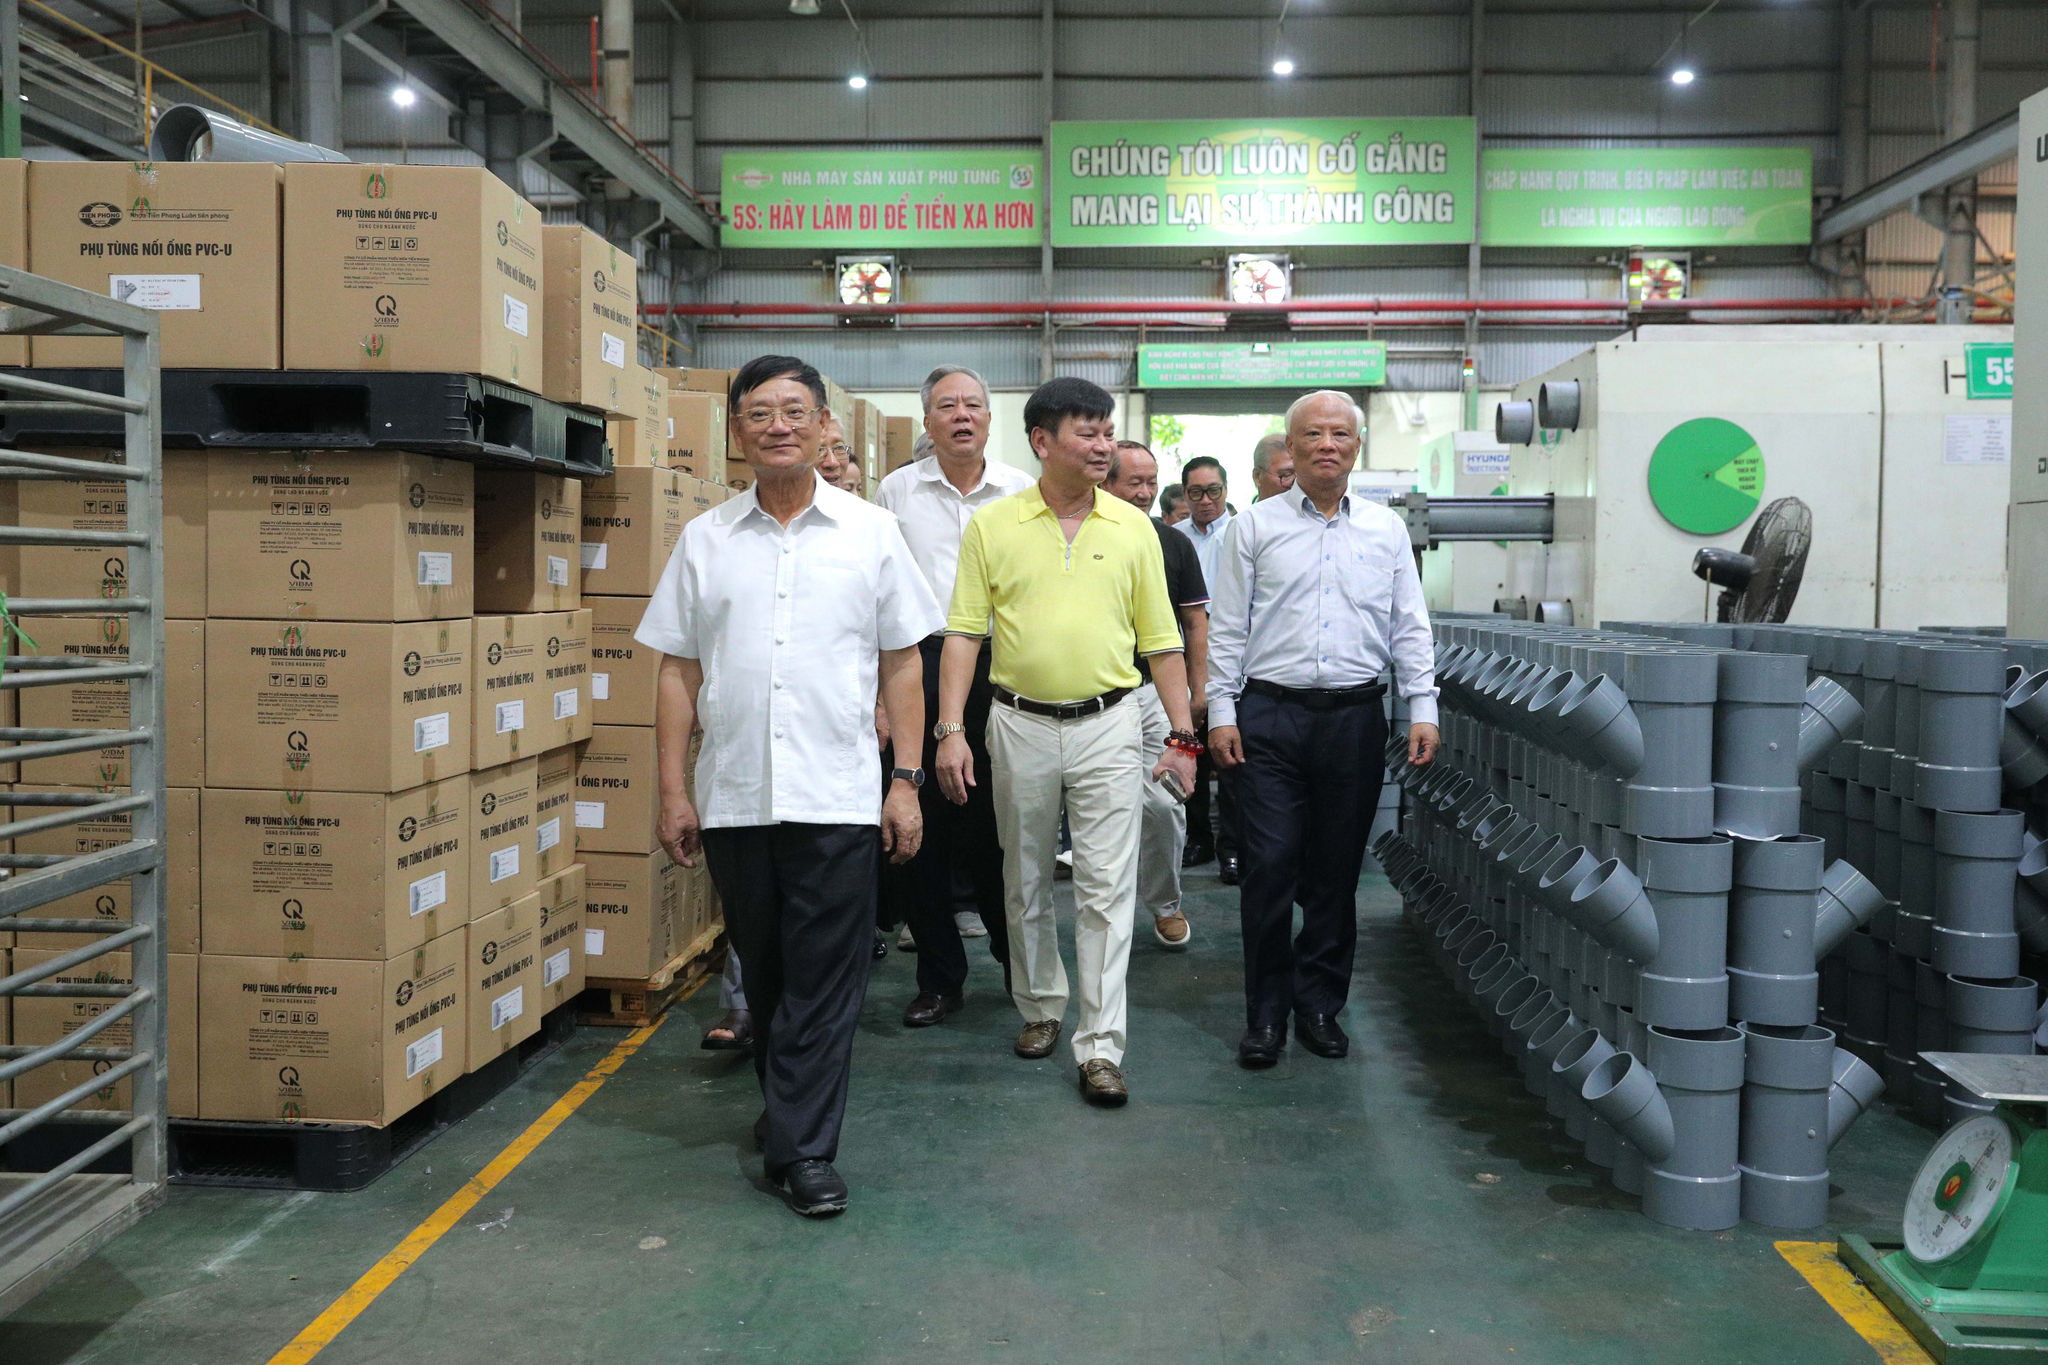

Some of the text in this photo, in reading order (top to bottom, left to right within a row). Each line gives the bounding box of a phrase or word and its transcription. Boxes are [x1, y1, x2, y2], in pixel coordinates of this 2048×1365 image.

[1072, 131, 1446, 177] CHÚNG TÔI LUÔN CỐ GẮNG
[928, 170, 957, 188] PHỤ
[337, 208, 437, 220] PHỤ TÙNG NỐI ỐNG PVC-U
[733, 204, 762, 230] 5S:
[769, 198, 806, 230] HÃY
[813, 197, 852, 230] LÀM
[859, 204, 877, 230] ĐI
[884, 192, 909, 229] ĐỂ
[963, 203, 988, 229] XA
[995, 200, 1034, 229] HƠN
[1071, 194, 1158, 226] MANG
[1167, 194, 1212, 231] LẠI
[1268, 186, 1364, 224] THÀNH
[1374, 185, 1454, 224] CÔNG
[1686, 206, 1708, 227] LAO
[80, 238, 232, 258] PHỤ TÙNG NỐI ỐNG PVC-U
[252, 474, 349, 486] PHỤ TÙNG NỐI ỐNG PVC-U
[408, 521, 418, 537] PHỤ
[418, 522, 430, 535] TÙNG
[450, 524, 464, 537] PVC-U
[603, 518, 630, 528] PVC-U
[64, 645, 79, 656] PHỤ
[81, 644, 101, 654] TÙNG
[118, 643, 129, 655] ỐN
[250, 647, 266, 658] PHỤ
[268, 646, 288, 656] TÙNG
[305, 646, 322, 658] ỐNG
[323, 648, 346, 658] PVC-U
[592, 648, 632, 659] NG PVC-U
[403, 683, 462, 705] PHỤ TÙNG NỐI ỐNG PVC-U
[581, 775, 629, 789] ỐNG PVC-U
[245, 815, 260, 826] PHỤ
[262, 815, 282, 826] TÙNG
[299, 815, 315, 827] ỐNG
[316, 818, 340, 827] PVC-U
[397, 856, 408, 871] PHỤ
[408, 850, 422, 866] TÙNG
[432, 843, 443, 858] ỐNG
[443, 838, 458, 854] PVC-U
[586, 903, 628, 915] NG PVC-U
[242, 983, 258, 994] PHỤ
[259, 983, 279, 993] TÙNG
[295, 984, 312, 995] ỐNG
[314, 985, 337, 995] PVC-U
[394, 992, 456, 1036] PHỤ TÙNG NỐI ỐNG PVC-U
